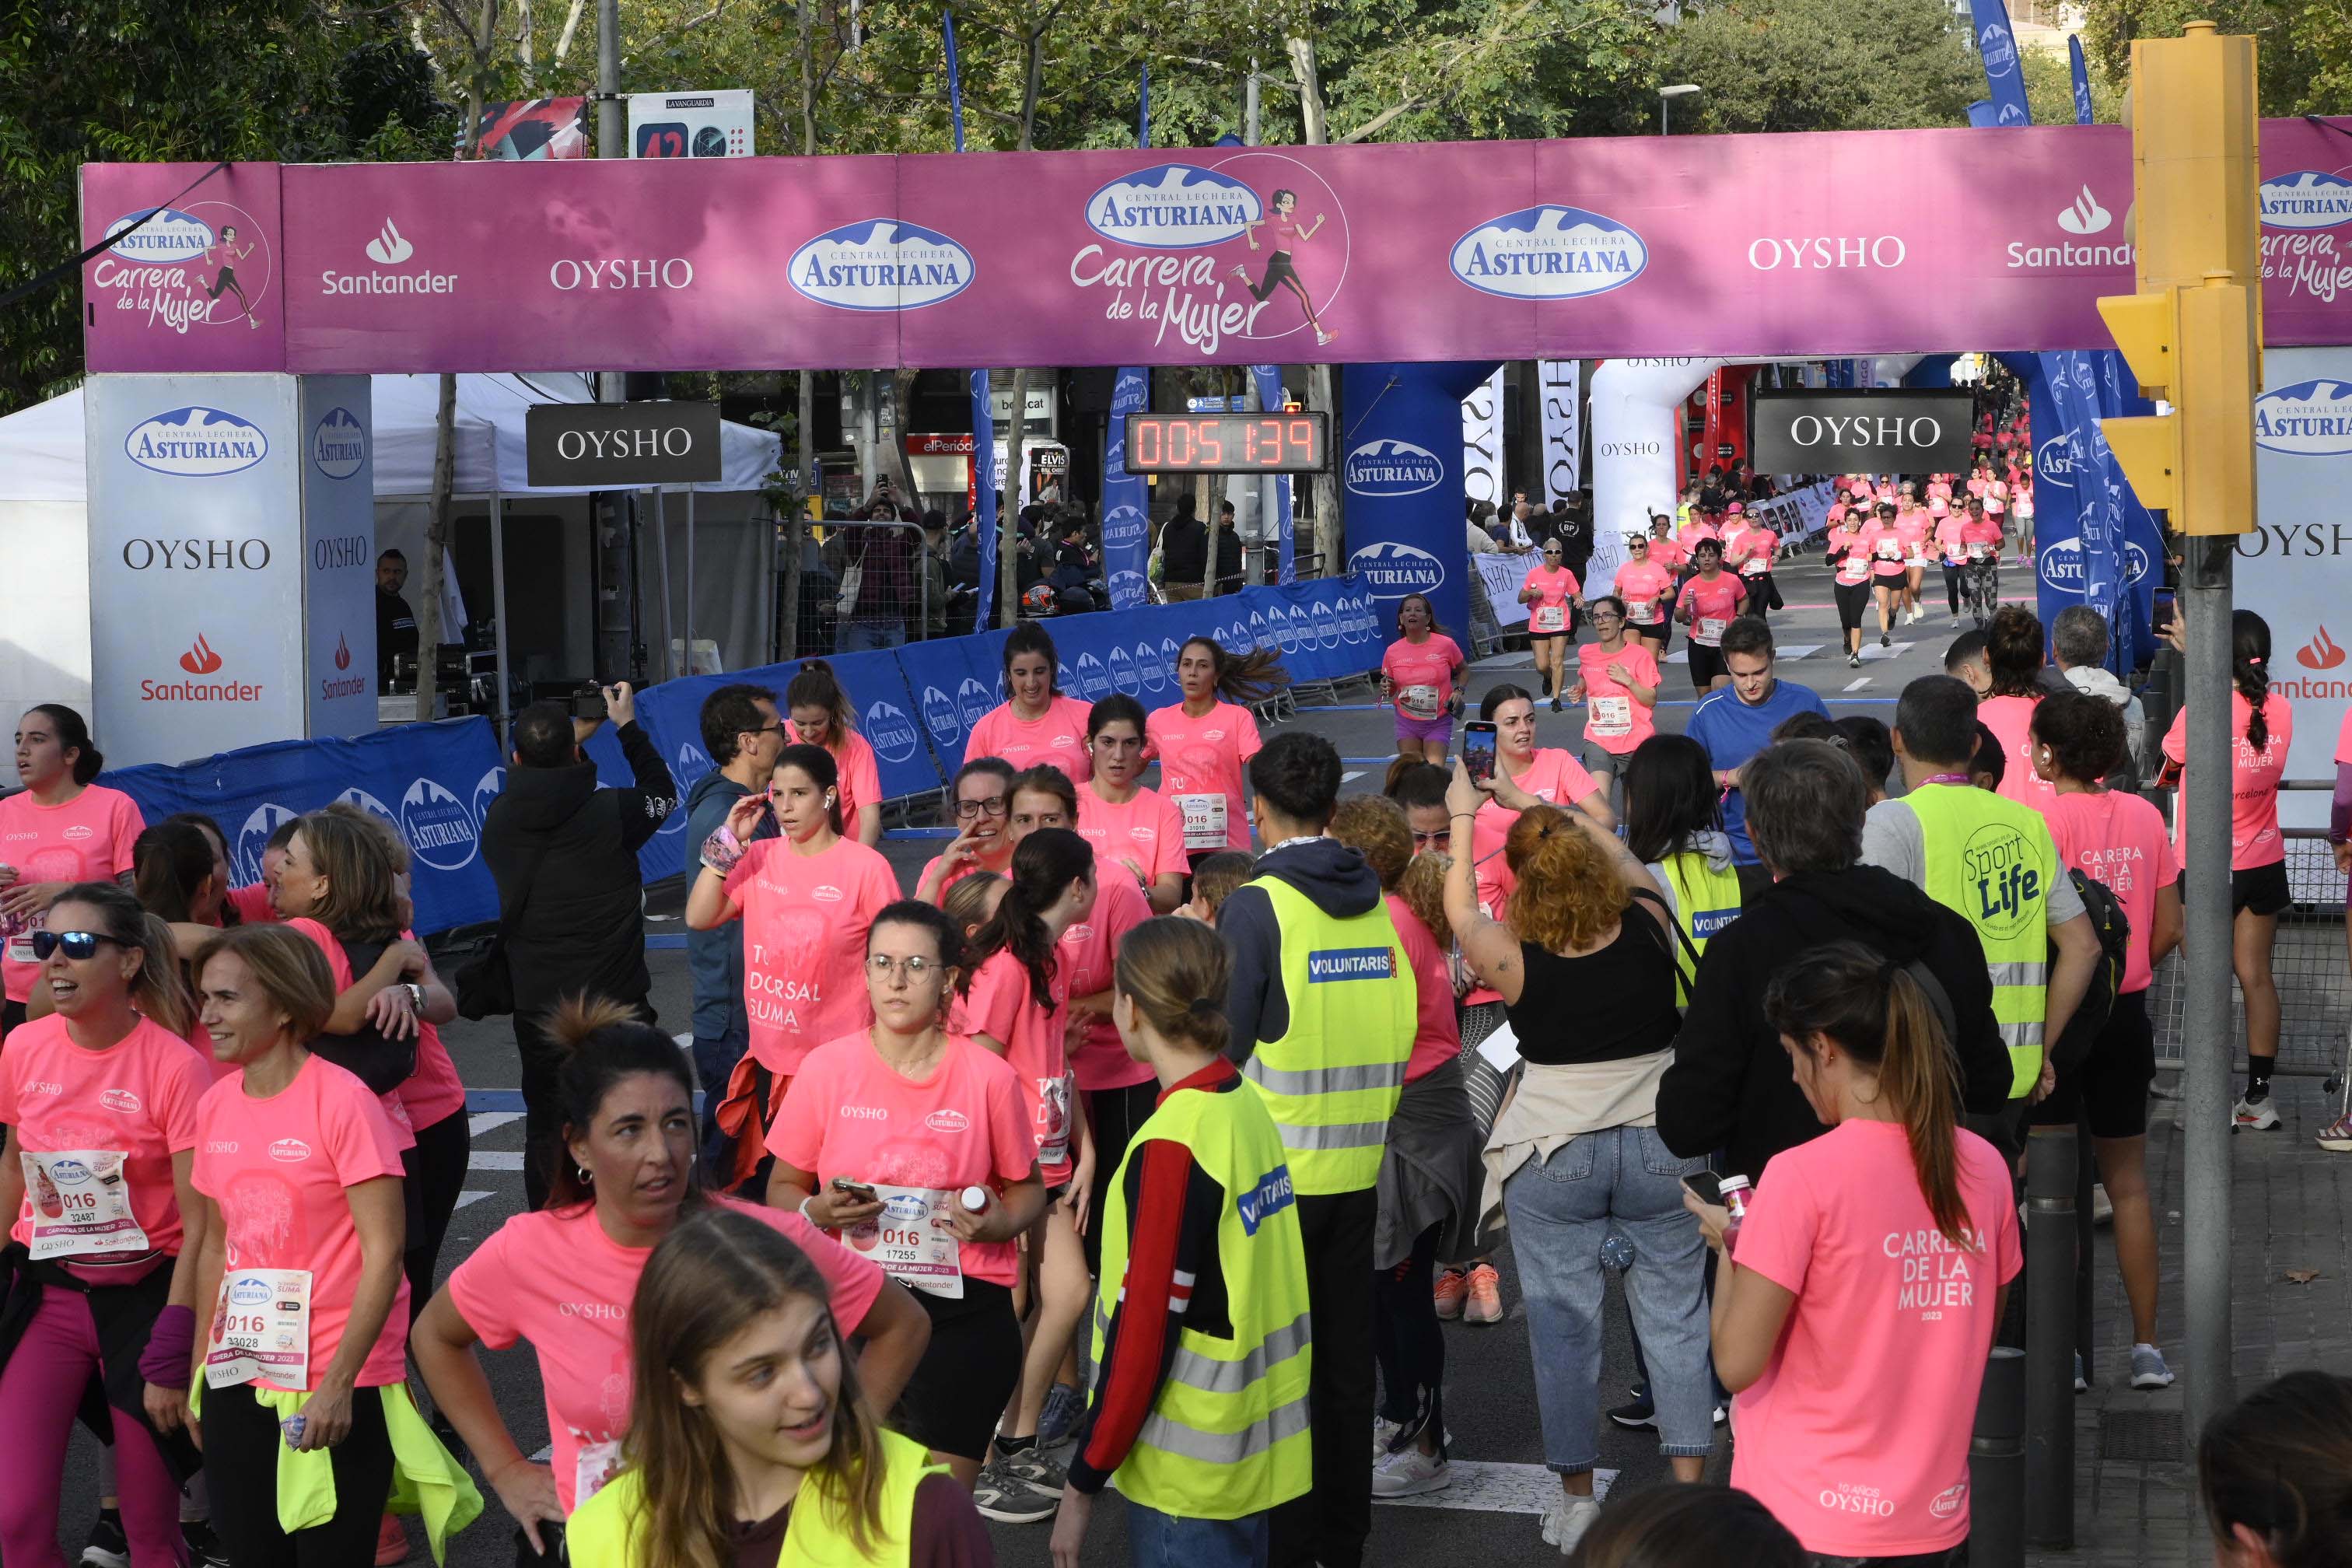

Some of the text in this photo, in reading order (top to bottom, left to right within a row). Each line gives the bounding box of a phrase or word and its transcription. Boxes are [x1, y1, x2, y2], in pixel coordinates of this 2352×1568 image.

[1126, 192, 1243, 202] CENTRAL LECHERA
[1099, 196, 1248, 227] ASTURIANA
[112, 228, 205, 249] ASTURIANA
[1496, 236, 1626, 248] CENTRAL LECHERA
[2260, 233, 2335, 256] arrera
[831, 250, 954, 261] CENTRAL LECHERA
[1465, 241, 1632, 276] ASTURIANA
[1748, 235, 1906, 271] OYSHO
[94, 259, 185, 288] Carrera
[550, 257, 693, 290] OYSHO
[802, 254, 960, 287] ASTURIANA
[1070, 243, 1215, 287] Carrera
[2279, 255, 2292, 278] la
[321, 270, 458, 296] Santander
[117, 285, 221, 334] de la Mujer
[1106, 282, 1269, 355] de la Mujer
[2277, 406, 2329, 415] CENTRAL
[158, 430, 202, 439] CENTRAL
[1790, 415, 1941, 447] OYSHO
[136, 432, 257, 459] ASTURIANA
[317, 441, 362, 462] ASTURIANA
[557, 427, 693, 460] OYSHO
[1601, 441, 1661, 457] OYSHO
[1041, 454, 1065, 464] ELVIS
[1348, 462, 1437, 484] ASTURIANA
[123, 538, 271, 570] OYSHO
[314, 535, 366, 572] OYSHO
[1350, 563, 1437, 584] TURIANA
[141, 679, 262, 702] Santander
[322, 676, 365, 701] Santander
[2267, 676, 2352, 699] antan
[1002, 744, 1031, 754] OYSHO
[2231, 734, 2282, 747] CARA
[2238, 756, 2273, 768] MUJER
[1171, 778, 1185, 789] TU
[1187, 815, 1207, 824] 016
[5, 831, 38, 841] OYSHO
[408, 816, 474, 852] ASTURIANA
[1965, 834, 2024, 882] Sport
[2114, 862, 2130, 877] LA
[1977, 863, 2040, 920] Life
[2100, 877, 2133, 892] UJER
[30, 916, 45, 927] 01
[1310, 955, 1389, 975] VOLUNTARIS
[750, 999, 798, 1027] SUMA
[102, 1094, 138, 1110] ASTURIANA
[841, 1105, 888, 1121] OYSHO
[929, 1118, 965, 1129] ASTURIANA
[271, 1148, 308, 1157] ASTURIANA
[63, 1192, 96, 1208] 016
[71, 1212, 96, 1223] 32487
[103, 1235, 139, 1246] Santander
[883, 1228, 919, 1246] 016
[886, 1249, 916, 1260] 17255
[1903, 1255, 1970, 1283] DE LA
[915, 1280, 954, 1289] Santander
[233, 1290, 268, 1300] ASTURIANA
[1898, 1282, 1972, 1311] MUJER
[559, 1302, 626, 1319] OYSHO
[1920, 1311, 1942, 1321] 2023
[227, 1315, 264, 1332] 016
[227, 1337, 259, 1348] 33028
[264, 1370, 296, 1380] antander
[1837, 1482, 1880, 1498] 10 AÑOS
[1819, 1489, 1895, 1517] OYSHO
